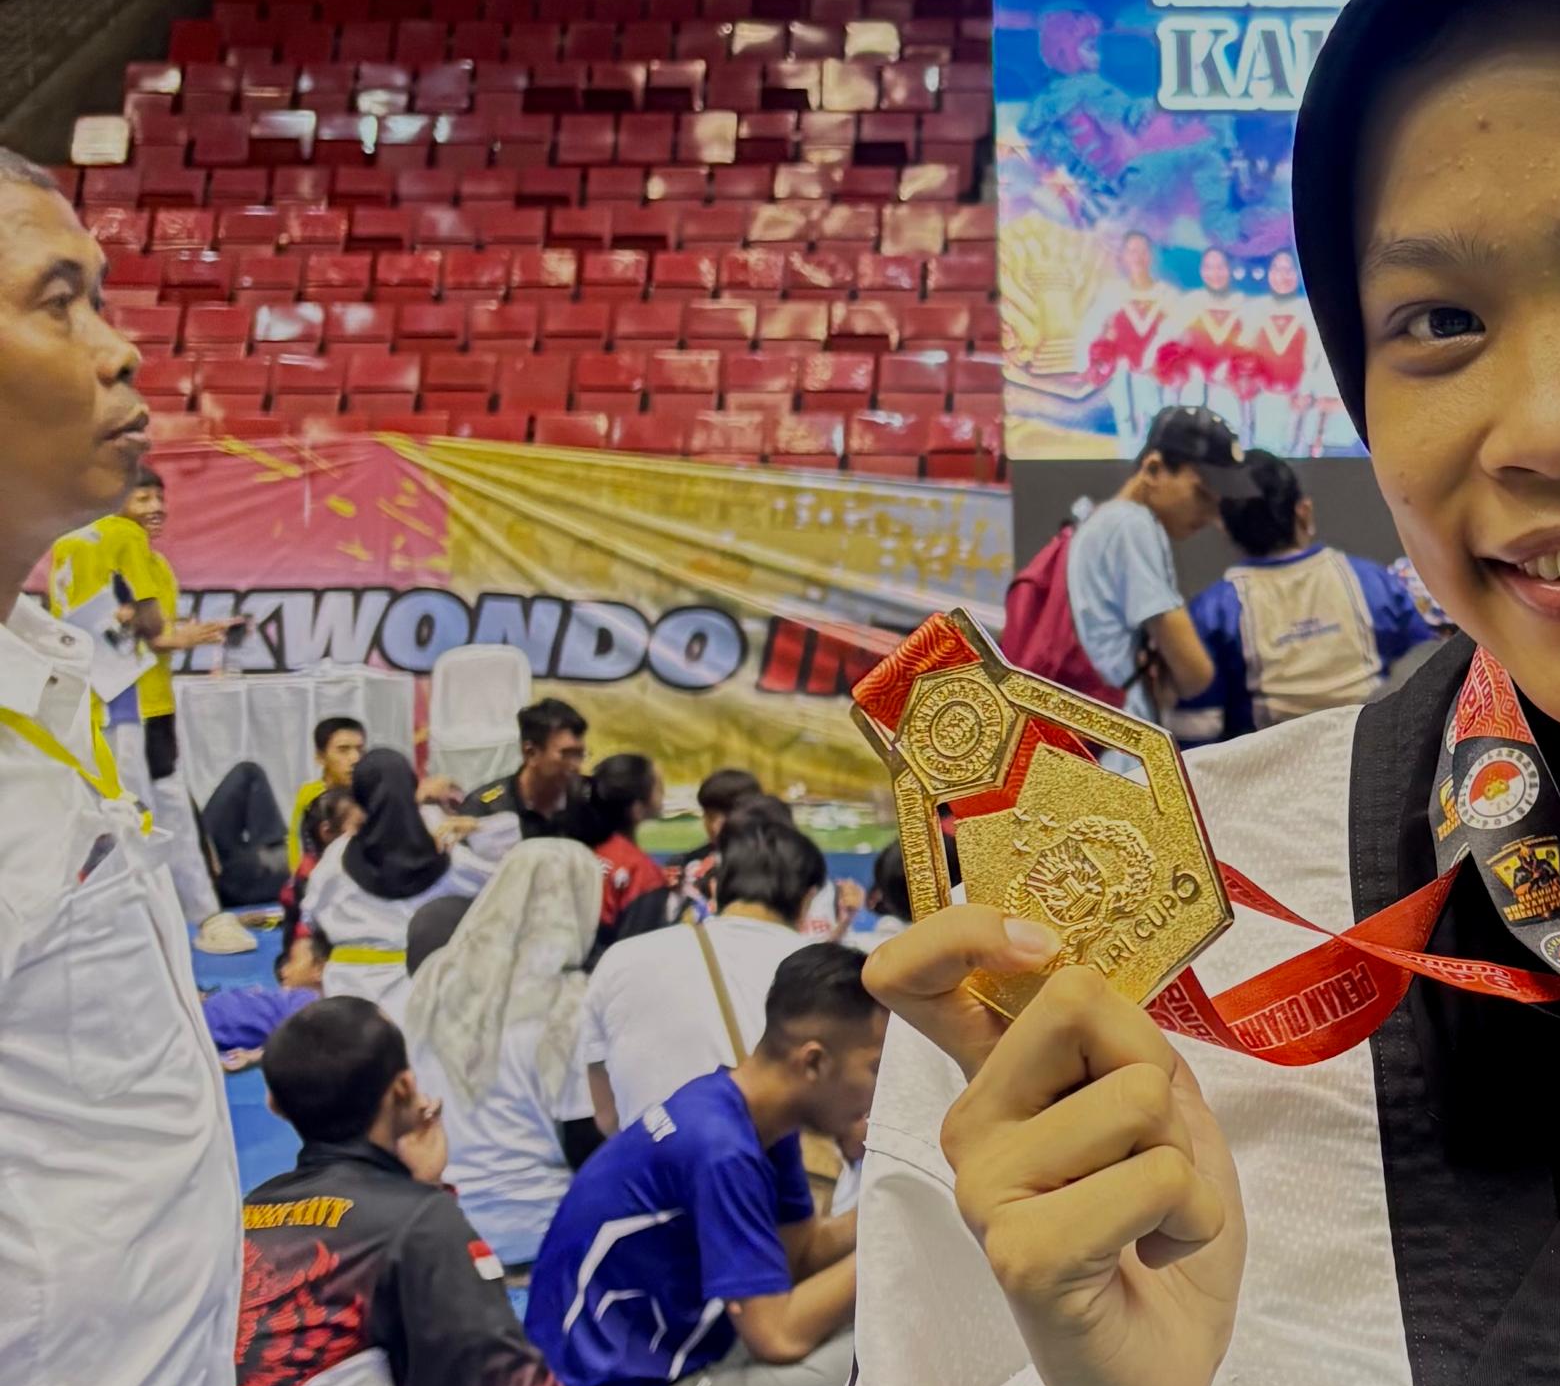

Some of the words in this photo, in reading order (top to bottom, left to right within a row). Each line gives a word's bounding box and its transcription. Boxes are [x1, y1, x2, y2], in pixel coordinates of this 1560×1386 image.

[1170, 28, 1325, 100] KA
[172, 589, 742, 690] KWONDO
[1134, 894, 1178, 941] CUP
[1172, 863, 1202, 905] 6
[1299, 961, 1379, 1031] PEKAN
